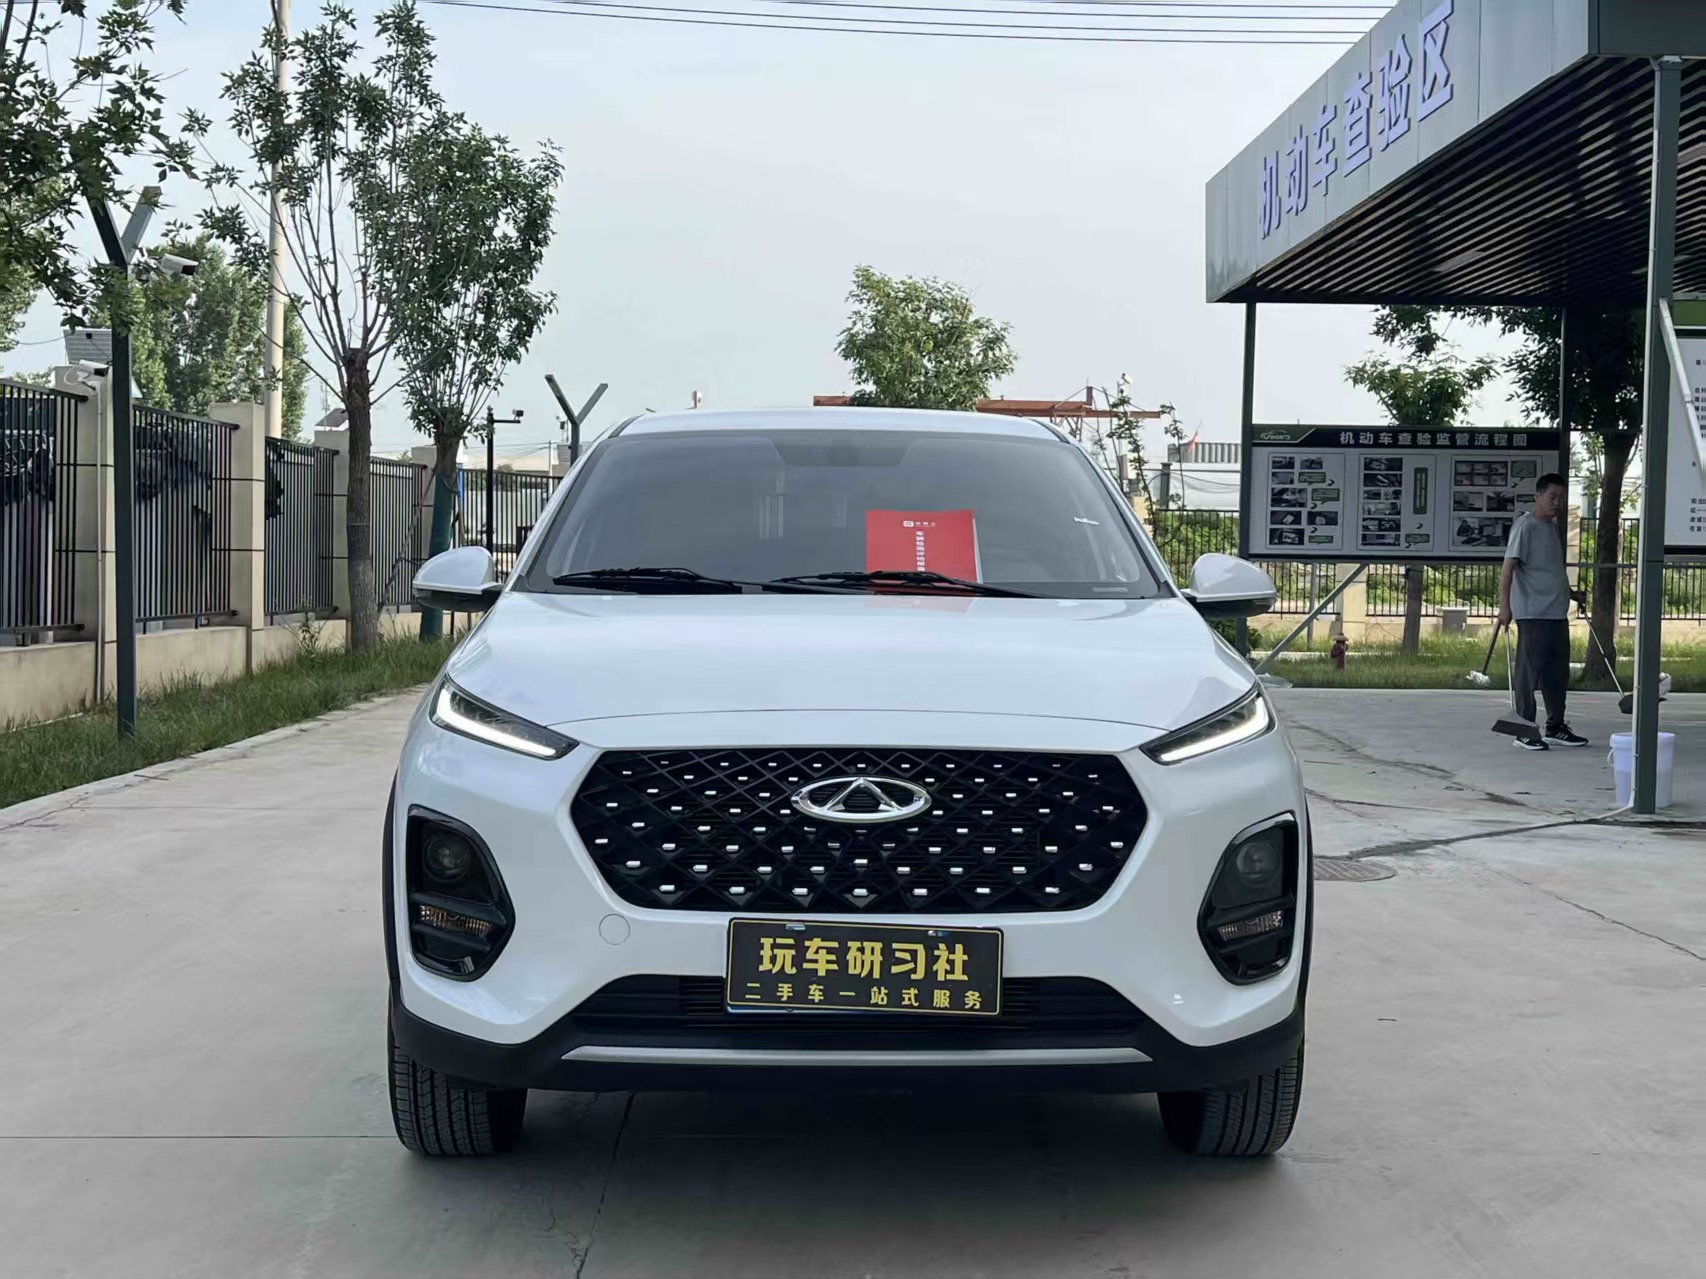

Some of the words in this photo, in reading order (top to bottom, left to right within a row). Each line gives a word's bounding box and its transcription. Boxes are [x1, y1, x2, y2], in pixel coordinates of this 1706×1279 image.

[1260, 1, 1454, 240] 机动车查验区
[1340, 431, 1527, 446] 机动车查验监管流程图
[758, 937, 969, 981] 玩车研习社
[745, 982, 982, 1009] 二手车一站式服务
